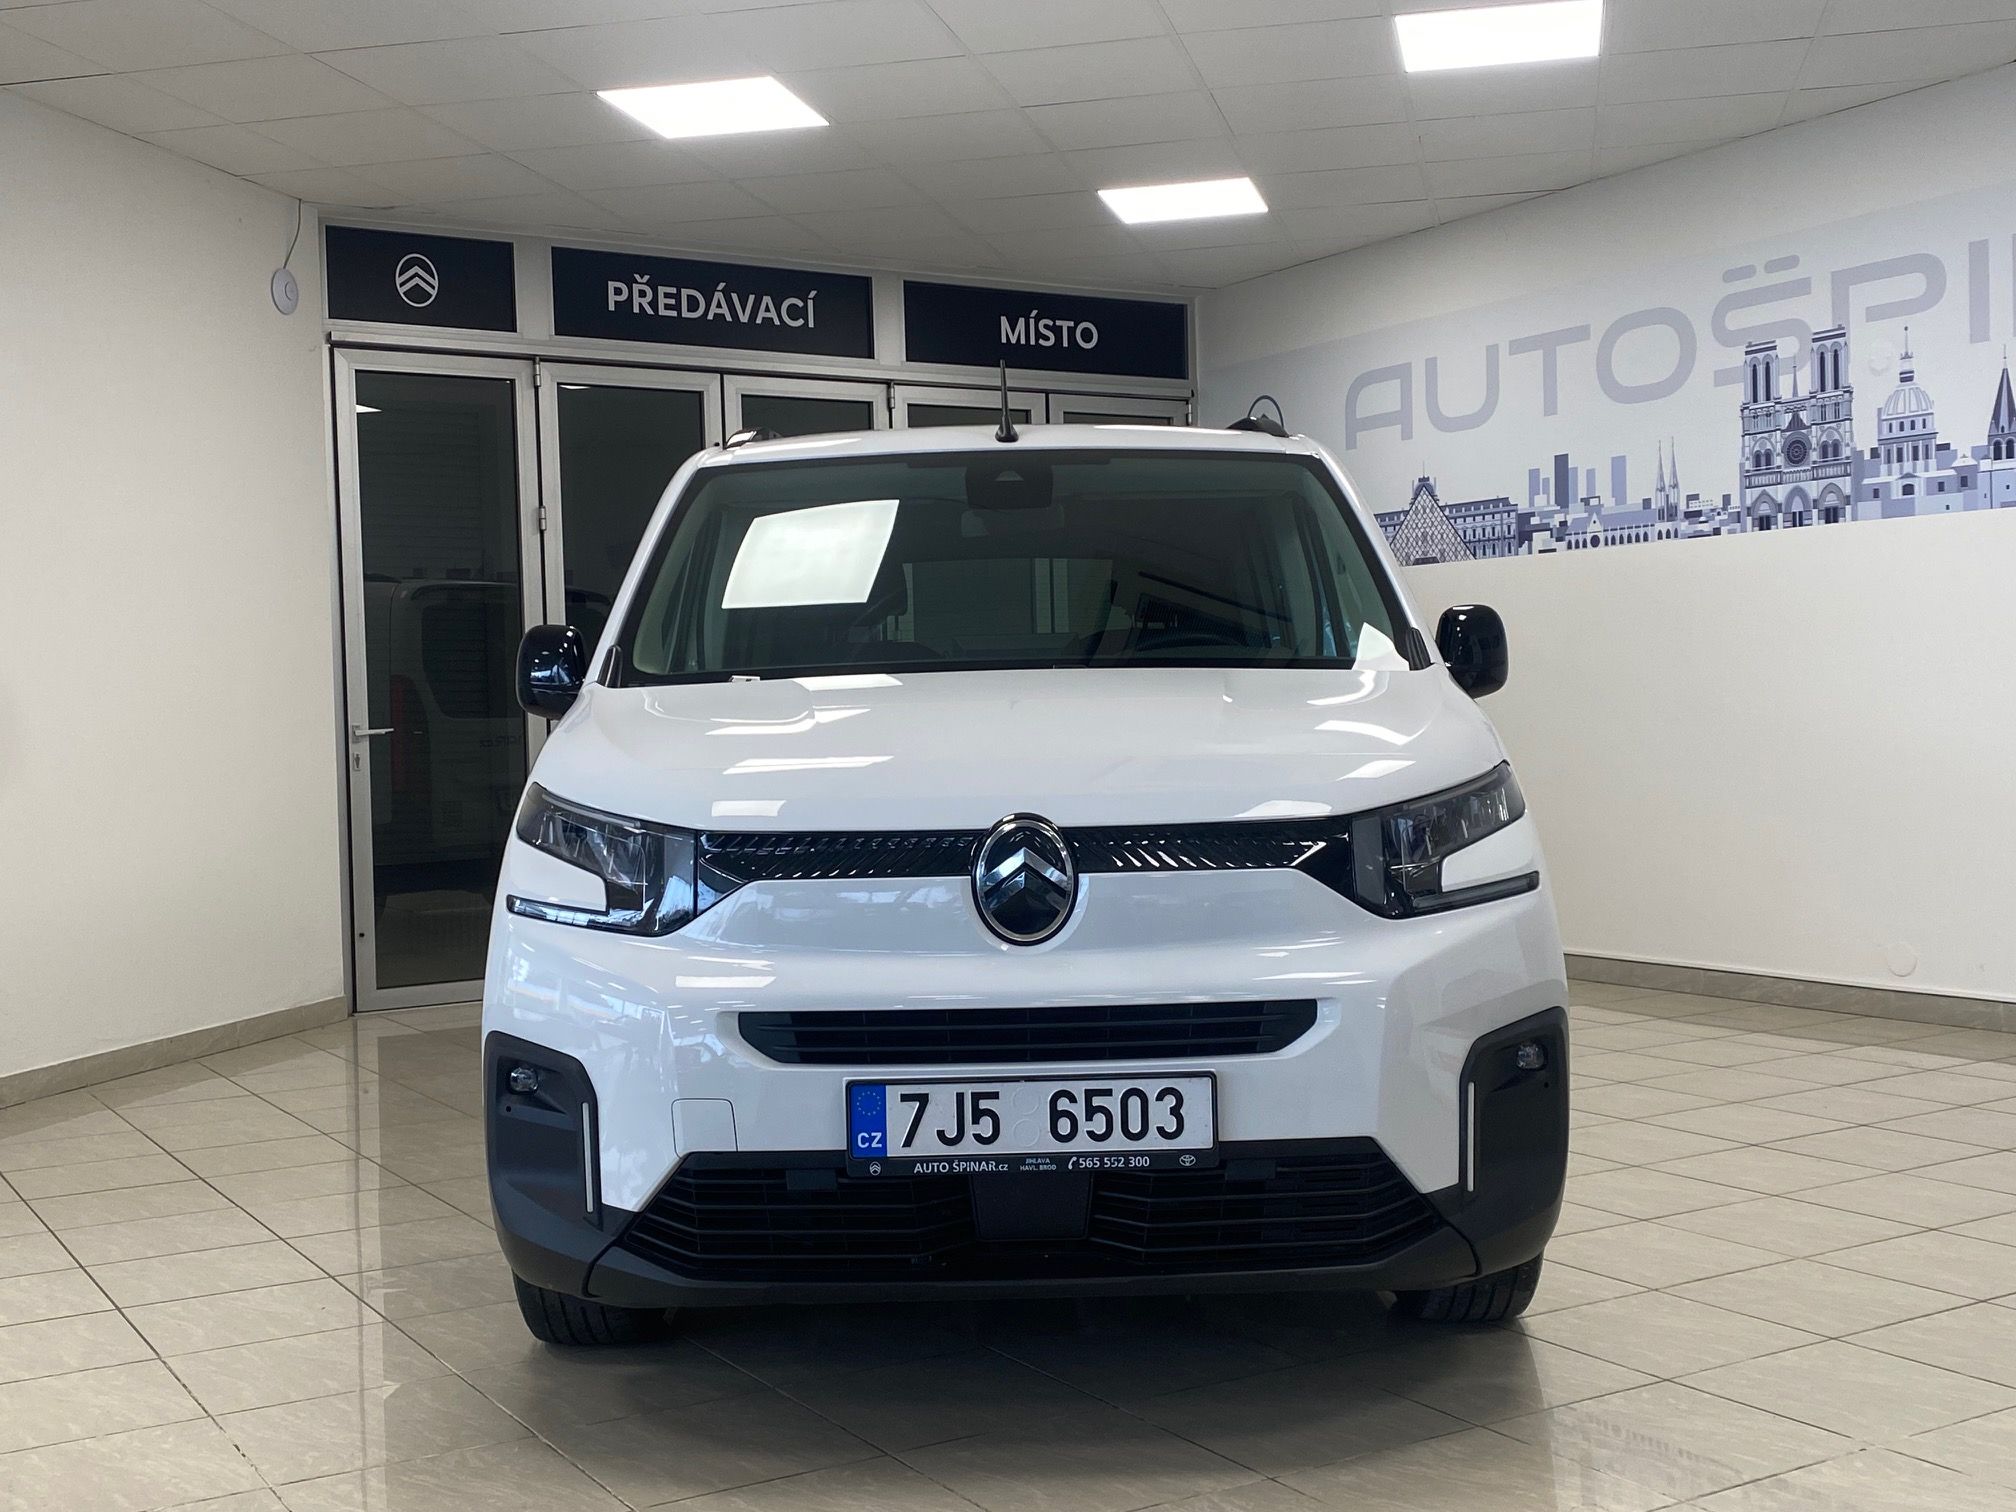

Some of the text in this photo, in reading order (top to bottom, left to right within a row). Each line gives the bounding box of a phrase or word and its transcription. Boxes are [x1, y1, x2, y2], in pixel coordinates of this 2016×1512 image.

[607, 273, 1098, 350] PŘEDÁVACÍ MÍSTO
[1345, 233, 2016, 450] AUTOŠPI
[899, 1086, 1185, 1149] 7J5 6503
[857, 1131, 883, 1149] CZ
[913, 1162, 949, 1174] AUTO
[1079, 1156, 1150, 1168] 565 552 300
